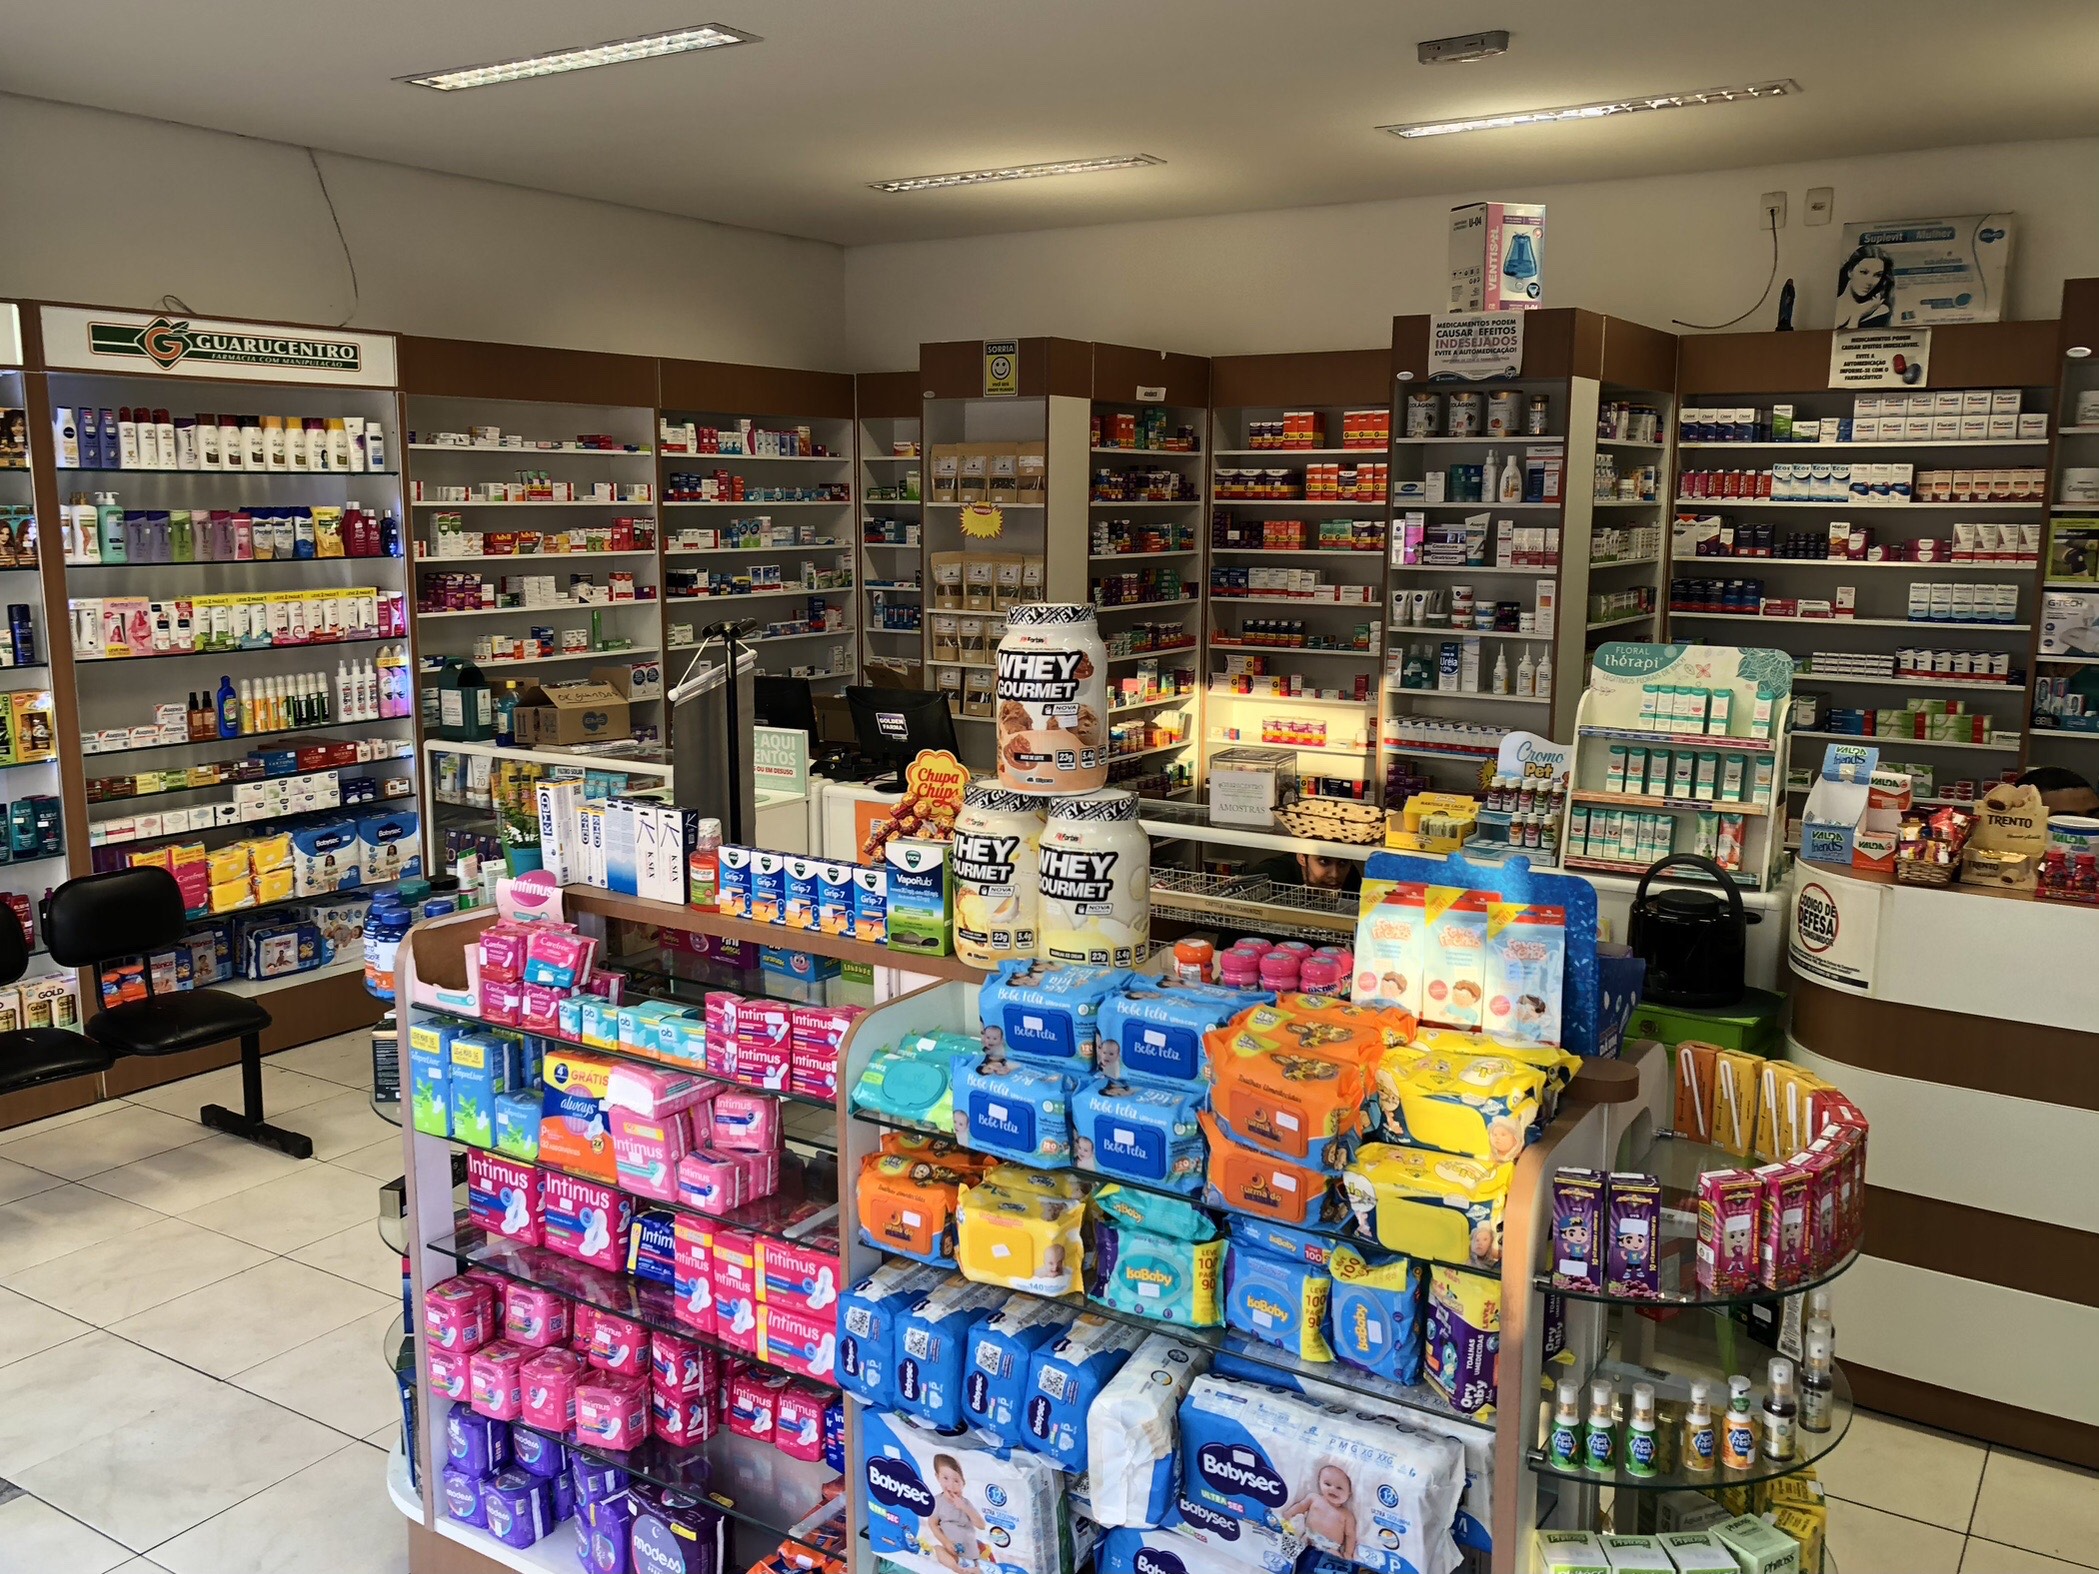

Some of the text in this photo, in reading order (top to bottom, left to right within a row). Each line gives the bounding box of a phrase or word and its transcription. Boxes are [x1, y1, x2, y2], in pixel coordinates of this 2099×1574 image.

[1468, 216, 1482, 228] U-04
[1863, 229, 1952, 244] Suplevit Mulher
[1436, 320, 1490, 329] MEDICAMENTOS
[1436, 328, 1516, 338] CAUSAR EFEITOS
[196, 335, 355, 359] GUARUCENTRO
[987, 344, 1014, 353] SORRIA
[1435, 336, 1517, 349] INDESEJADOS
[1459, 347, 1517, 356] AUTOMEDICAÇÃO!
[211, 353, 343, 368] FARMÁCIA COM MANIPULAÇÃO
[496, 533, 512, 541] Advil
[1616, 647, 1650, 655] FLORAL
[998, 652, 1080, 680] WHEY
[1440, 657, 1458, 666] Uréia
[998, 681, 1075, 700] GOURMET
[761, 734, 796, 750] AQUI
[754, 751, 796, 766] ENTOS
[1059, 752, 1073, 762] 23g
[1516, 740, 1564, 763] Cromo
[1836, 747, 1867, 755] VALDA
[918, 768, 959, 785] Chupa
[1524, 762, 1554, 779] Pet
[1871, 777, 1900, 787] VALDA
[916, 784, 959, 800] Chups
[1218, 804, 1265, 814] AMOSTRAS
[1988, 815, 2032, 828] TRENTO
[378, 827, 401, 837] Babysec
[1812, 831, 1843, 840] VALDA
[2053, 833, 2088, 845] VALDA
[316, 837, 339, 847] Babysec
[1858, 841, 1885, 850] VALDA
[956, 836, 1018, 864] HEY
[953, 860, 1010, 881] OURMET
[1968, 861, 1998, 870] TRENTO
[724, 872, 744, 882] Grip-7
[757, 878, 777, 889] Grip-7
[896, 874, 932, 887] VapoRub
[790, 883, 811, 894] Grip-7
[823, 888, 845, 900] Grip-7
[1825, 903, 1836, 918] DE
[1799, 906, 1834, 937] DEFESA
[994, 933, 1008, 942] 23g
[38, 988, 64, 999] GOLD
[792, 1013, 833, 1030] Intimus
[738, 1048, 781, 1064] Intimus
[792, 1054, 832, 1072] Intimus
[571, 1071, 609, 1086] GRÁTIS
[561, 1098, 596, 1114] always
[717, 1099, 752, 1110] Intimus
[613, 1136, 663, 1159] Intimus
[469, 1154, 529, 1190] Intimus
[680, 1167, 710, 1183] Intimus
[546, 1172, 609, 1209] Intimus
[1241, 1185, 1267, 1198] turma
[766, 1248, 816, 1276] Intimus
[1305, 1250, 1322, 1262] 100
[1341, 1258, 1360, 1280] 100
[714, 1270, 751, 1293] Intimus
[1030, 1282, 1044, 1292] 140
[1202, 1279, 1215, 1290] 90
[768, 1311, 819, 1341] Intimus
[846, 1339, 855, 1373] Babysec
[1466, 1338, 1475, 1369] TOALHAS
[1473, 1334, 1484, 1376] UMEDECIDAS
[906, 1362, 915, 1398] Babysec
[972, 1373, 983, 1411] Babysec
[780, 1396, 818, 1420] Intimus
[1033, 1398, 1046, 1435] Babysec
[1339, 1441, 1348, 1450] M
[1350, 1444, 1358, 1454] G
[1361, 1447, 1373, 1458] XG
[1377, 1452, 1393, 1464] XXG
[1203, 1452, 1280, 1496] Babysec
[869, 1466, 930, 1505] Babysec
[1201, 1489, 1243, 1514] ULTRA SEC
[1384, 1491, 1394, 1500] 12
[887, 1513, 899, 1524] SEC
[1180, 1499, 1236, 1532] Babysec
[1371, 1509, 1386, 1517] ULTRA
[634, 1534, 681, 1572] modess
[1390, 1555, 1401, 1572] P
[1764, 1553, 1794, 1574] Phitoss
